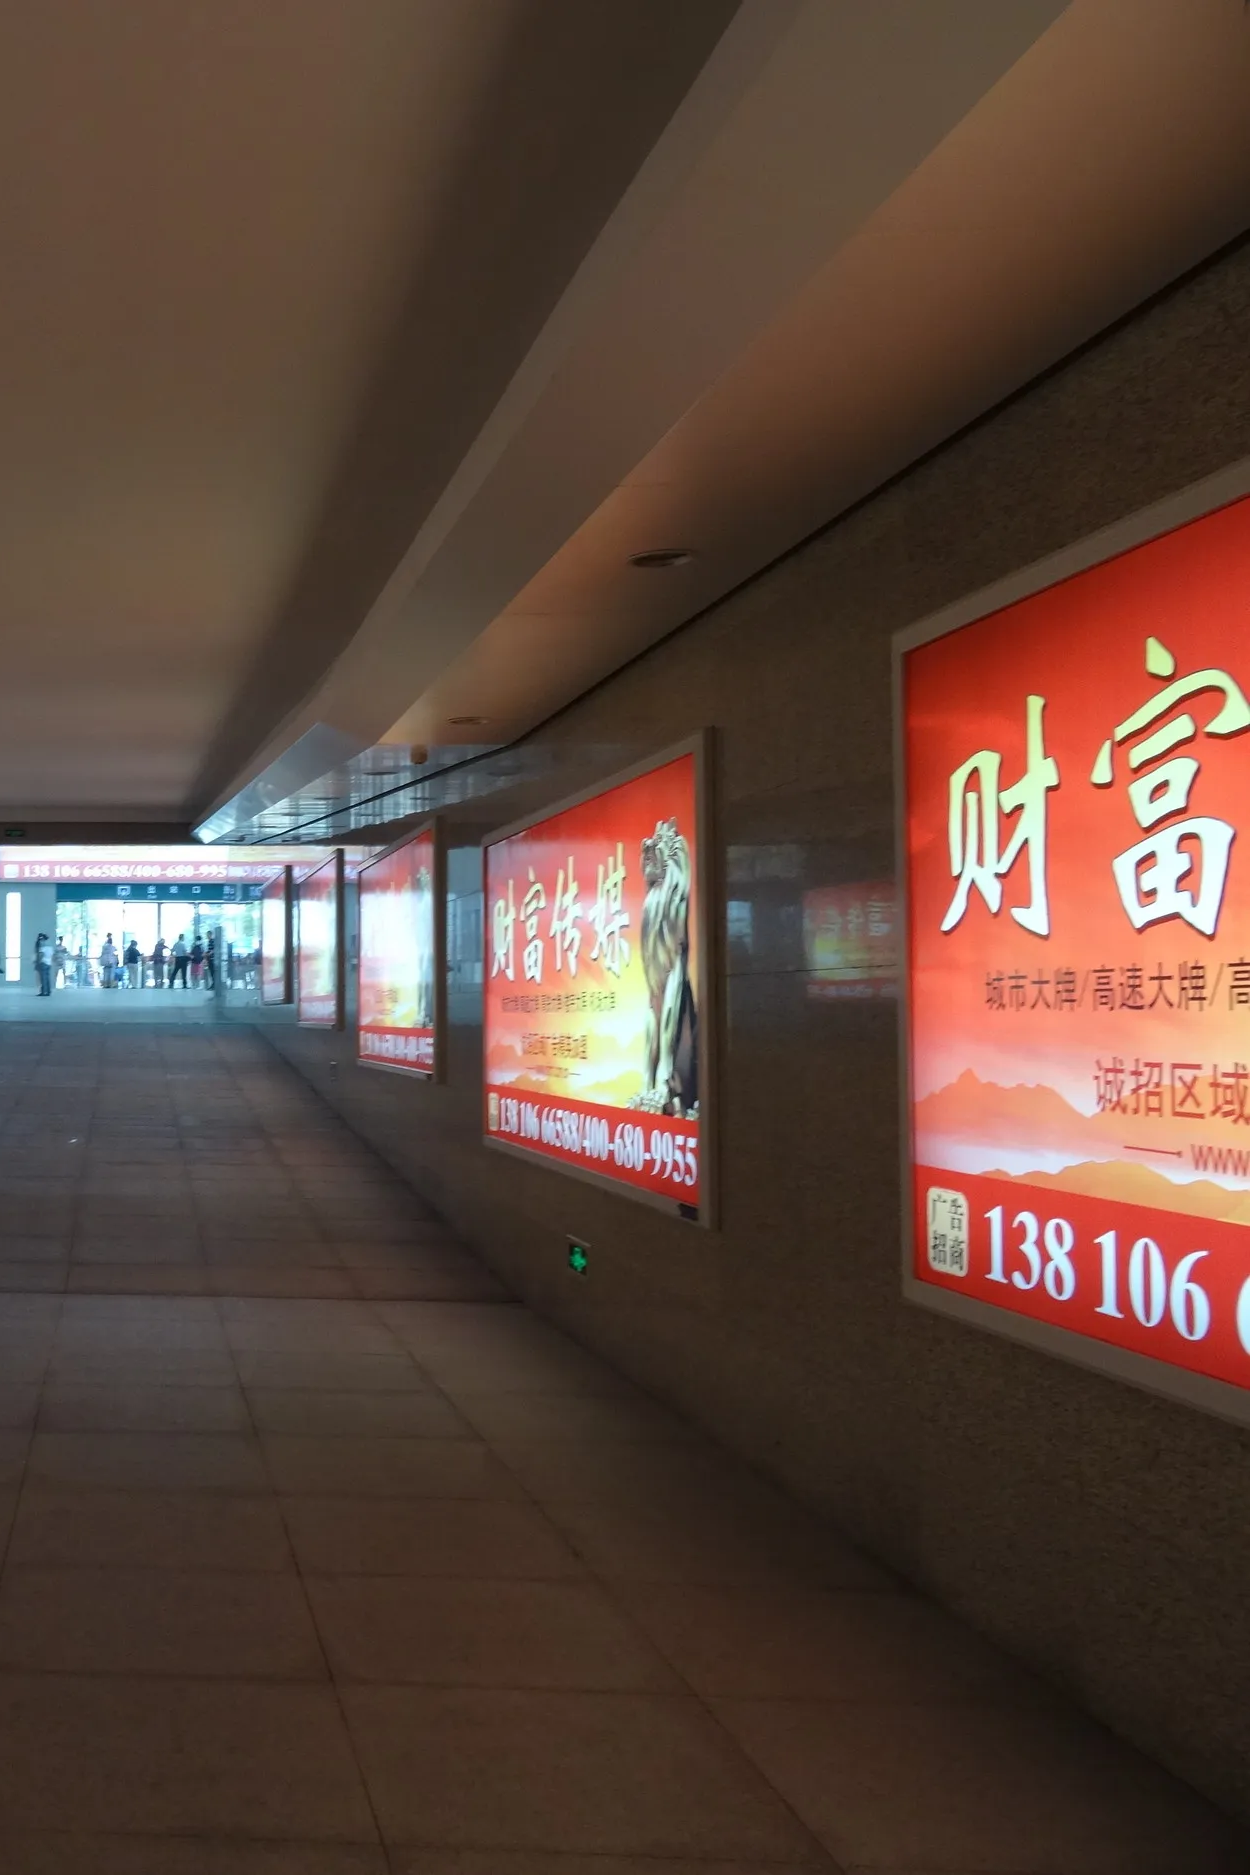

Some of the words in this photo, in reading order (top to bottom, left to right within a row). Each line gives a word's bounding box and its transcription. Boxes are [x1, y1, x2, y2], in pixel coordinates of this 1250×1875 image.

[940, 637, 1250, 940] 财富
[22, 864, 50, 878] 138
[53, 864, 81, 878] 106
[491, 842, 630, 985] 财富传媒
[500, 1097, 519, 1134] 138
[520, 1101, 540, 1141] 106
[541, 1106, 698, 1186] 66588/400-680-9955
[1093, 1056, 1250, 1125] 诚招区域
[983, 1205, 1075, 1301] 138
[1093, 1229, 1210, 1341] 106
